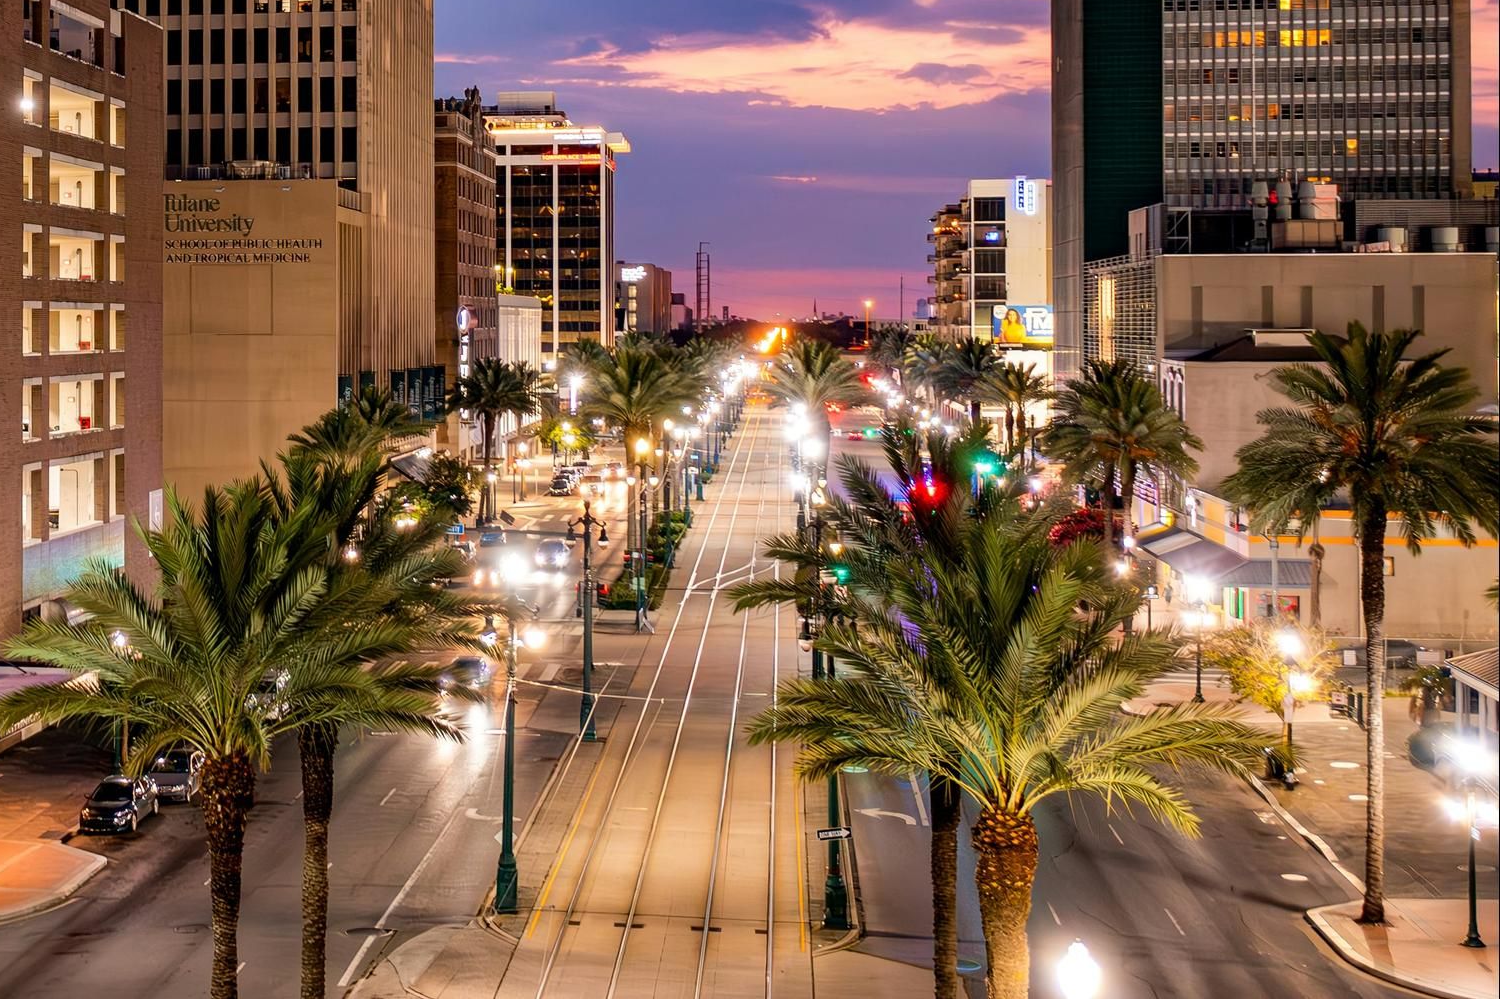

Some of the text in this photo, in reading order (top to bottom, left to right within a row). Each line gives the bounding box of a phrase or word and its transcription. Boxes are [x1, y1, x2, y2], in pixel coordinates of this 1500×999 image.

[163, 193, 221, 212] Tulane
[164, 213, 254, 237] University
[165, 239, 322, 249] SCHOOL OF PUBLIC HEALTH
[166, 253, 311, 263] AND TROPICAL MEDICINE
